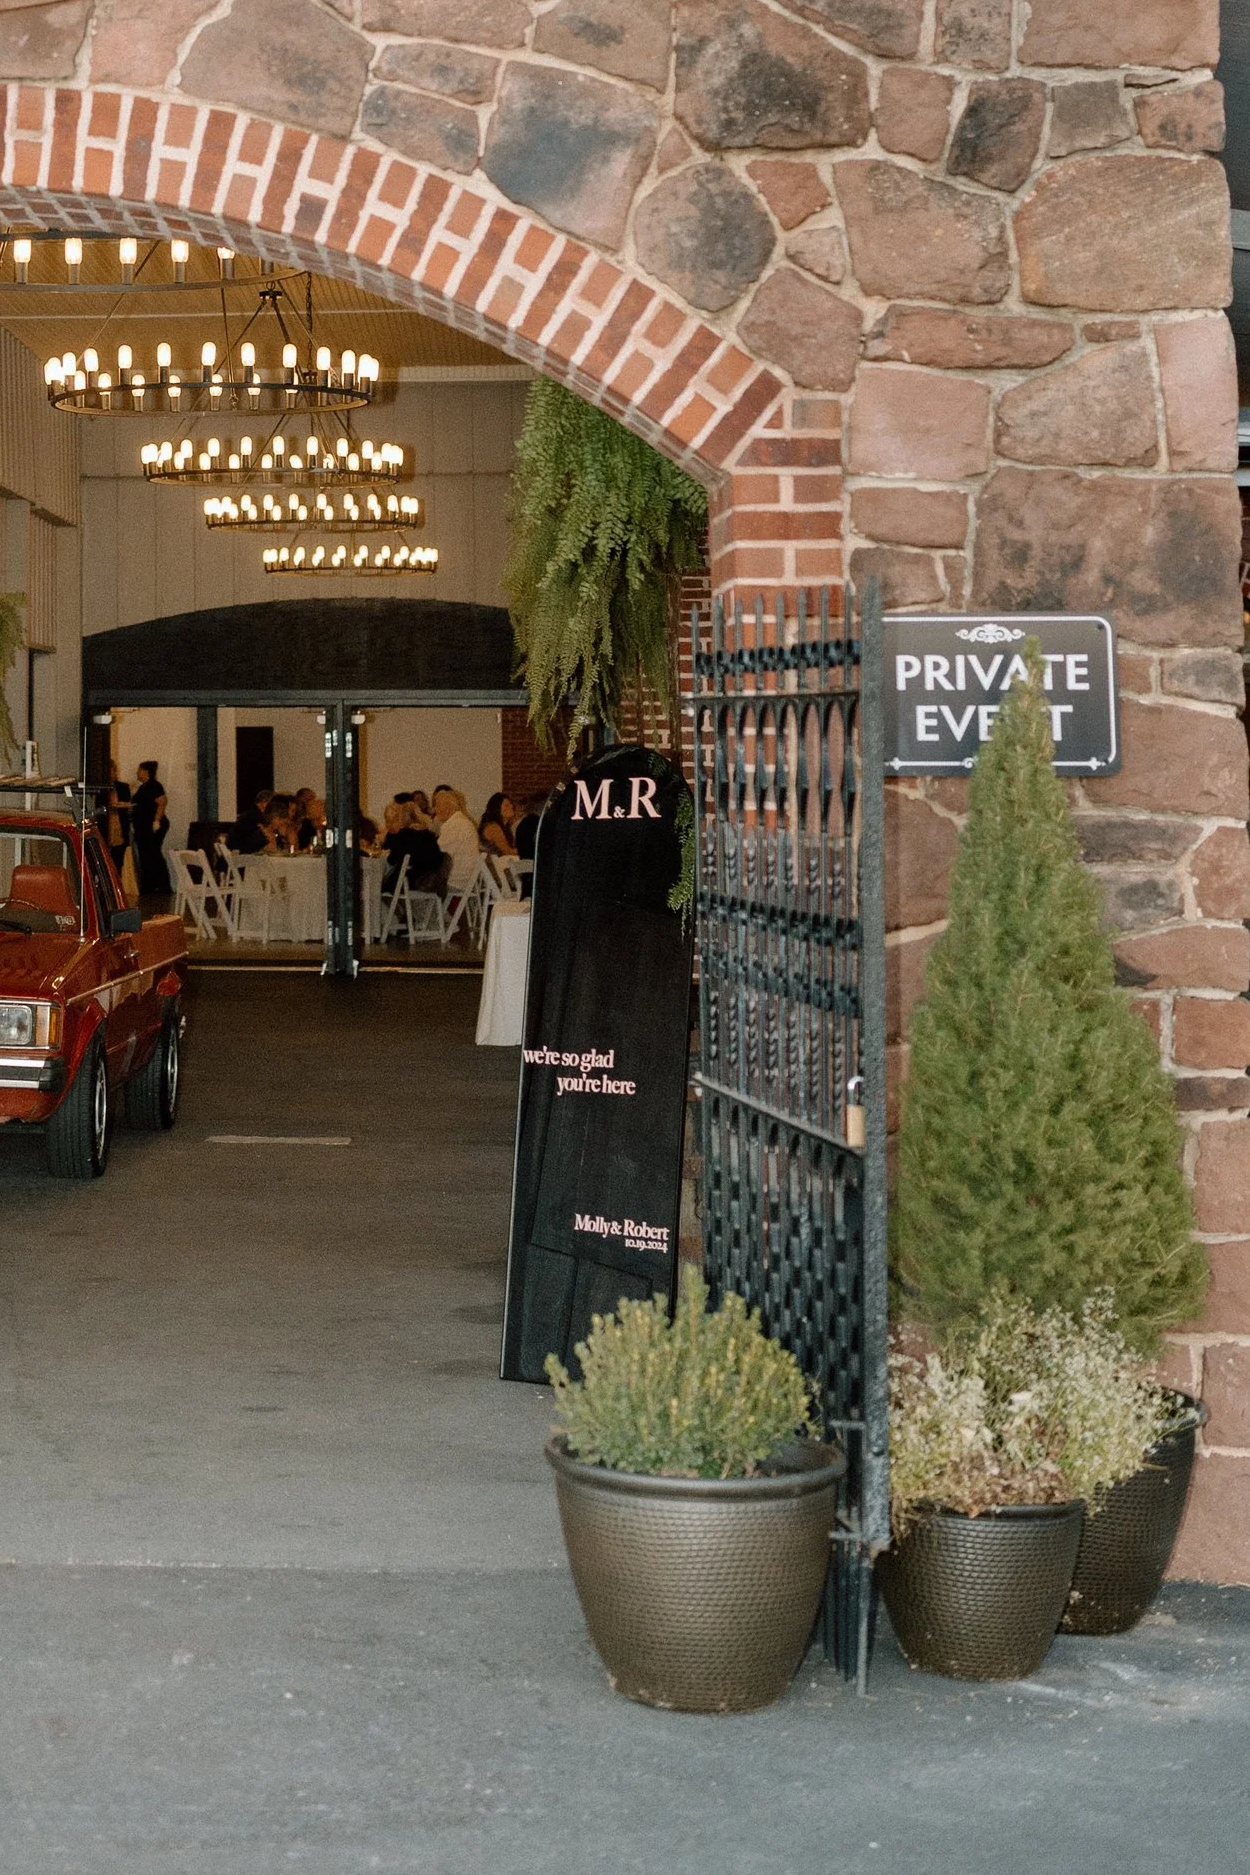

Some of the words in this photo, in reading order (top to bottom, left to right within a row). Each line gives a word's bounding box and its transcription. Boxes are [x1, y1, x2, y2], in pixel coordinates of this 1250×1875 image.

[895, 653, 1090, 691] PRIVATE
[915, 704, 1074, 742] EVET
[523, 1045, 560, 1065] we're
[561, 1052, 580, 1066] so
[580, 1048, 615, 1072] glad
[556, 1073, 601, 1096] you're
[602, 1073, 637, 1095] here
[573, 1212, 611, 1238] Molly
[622, 1218, 670, 1241] Robert
[624, 1237, 669, 1254] 10.19.2024
